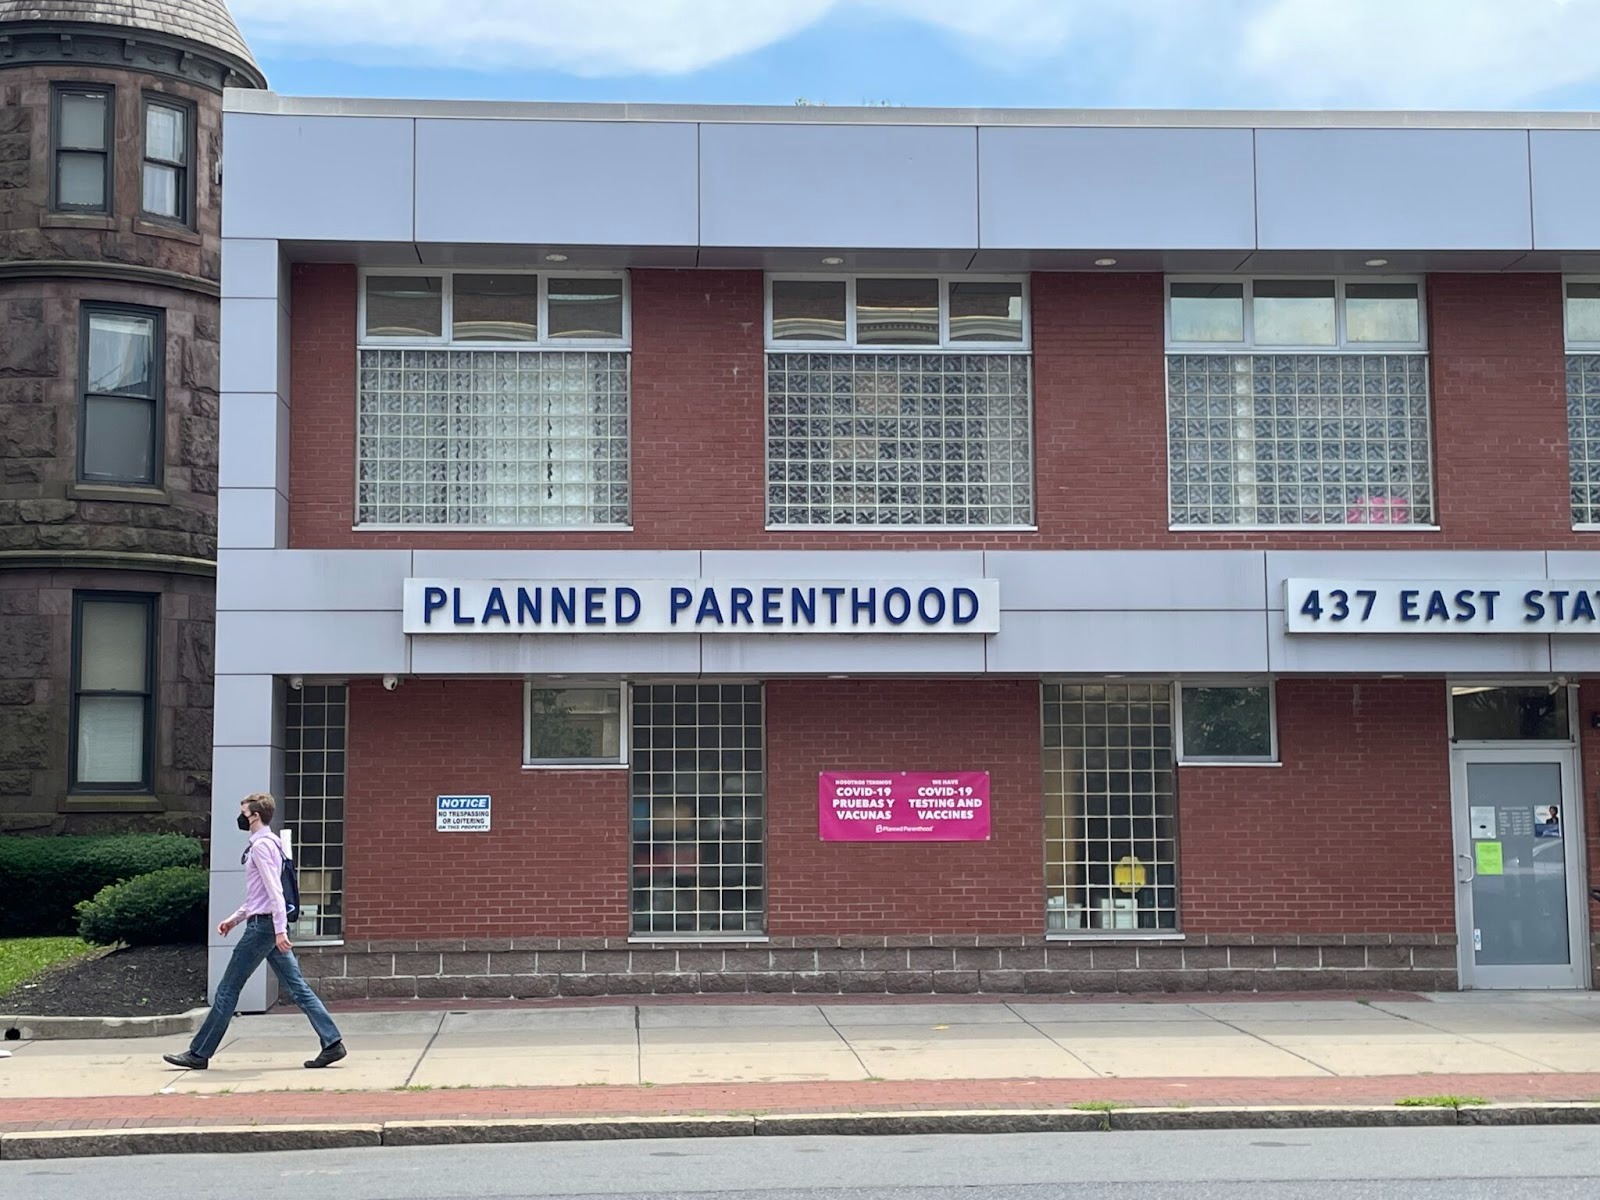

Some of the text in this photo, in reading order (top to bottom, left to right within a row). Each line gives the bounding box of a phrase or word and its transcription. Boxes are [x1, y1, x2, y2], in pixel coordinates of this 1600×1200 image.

[424, 587, 979, 624] PLANNED PARENTHOOD
[1301, 589, 1377, 621] 437
[1400, 590, 1500, 621] EAST
[836, 787, 891, 796] COVID-19
[918, 787, 973, 796] COVID-19
[441, 799, 486, 808] NOTICE
[833, 799, 895, 808] PRUEBAS Y
[909, 799, 983, 808] TESTING AND
[836, 810, 892, 820] VACUNAS
[918, 810, 974, 820] VACCINES
